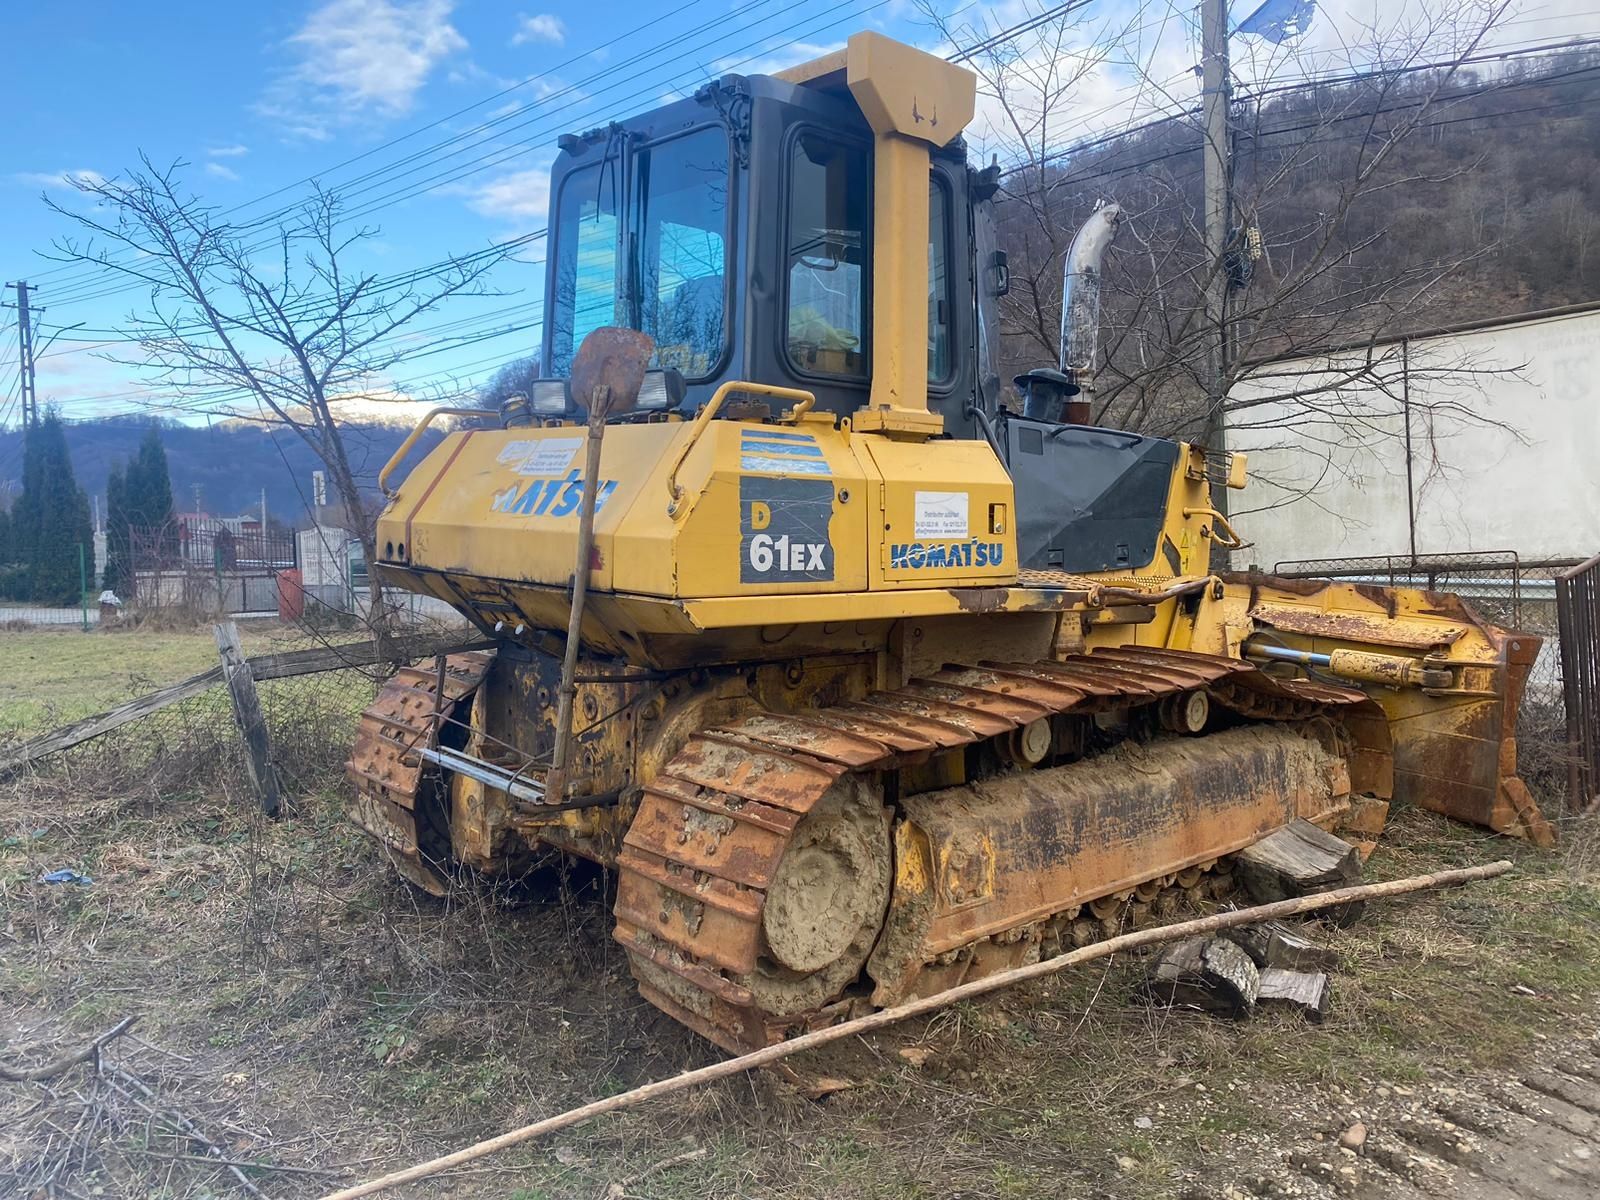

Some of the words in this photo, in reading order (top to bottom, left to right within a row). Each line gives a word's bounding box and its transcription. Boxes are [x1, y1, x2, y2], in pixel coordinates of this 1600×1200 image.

[751, 501, 771, 530] D
[749, 533, 826, 573] 61EX
[891, 536, 1003, 569] KOMATSU
